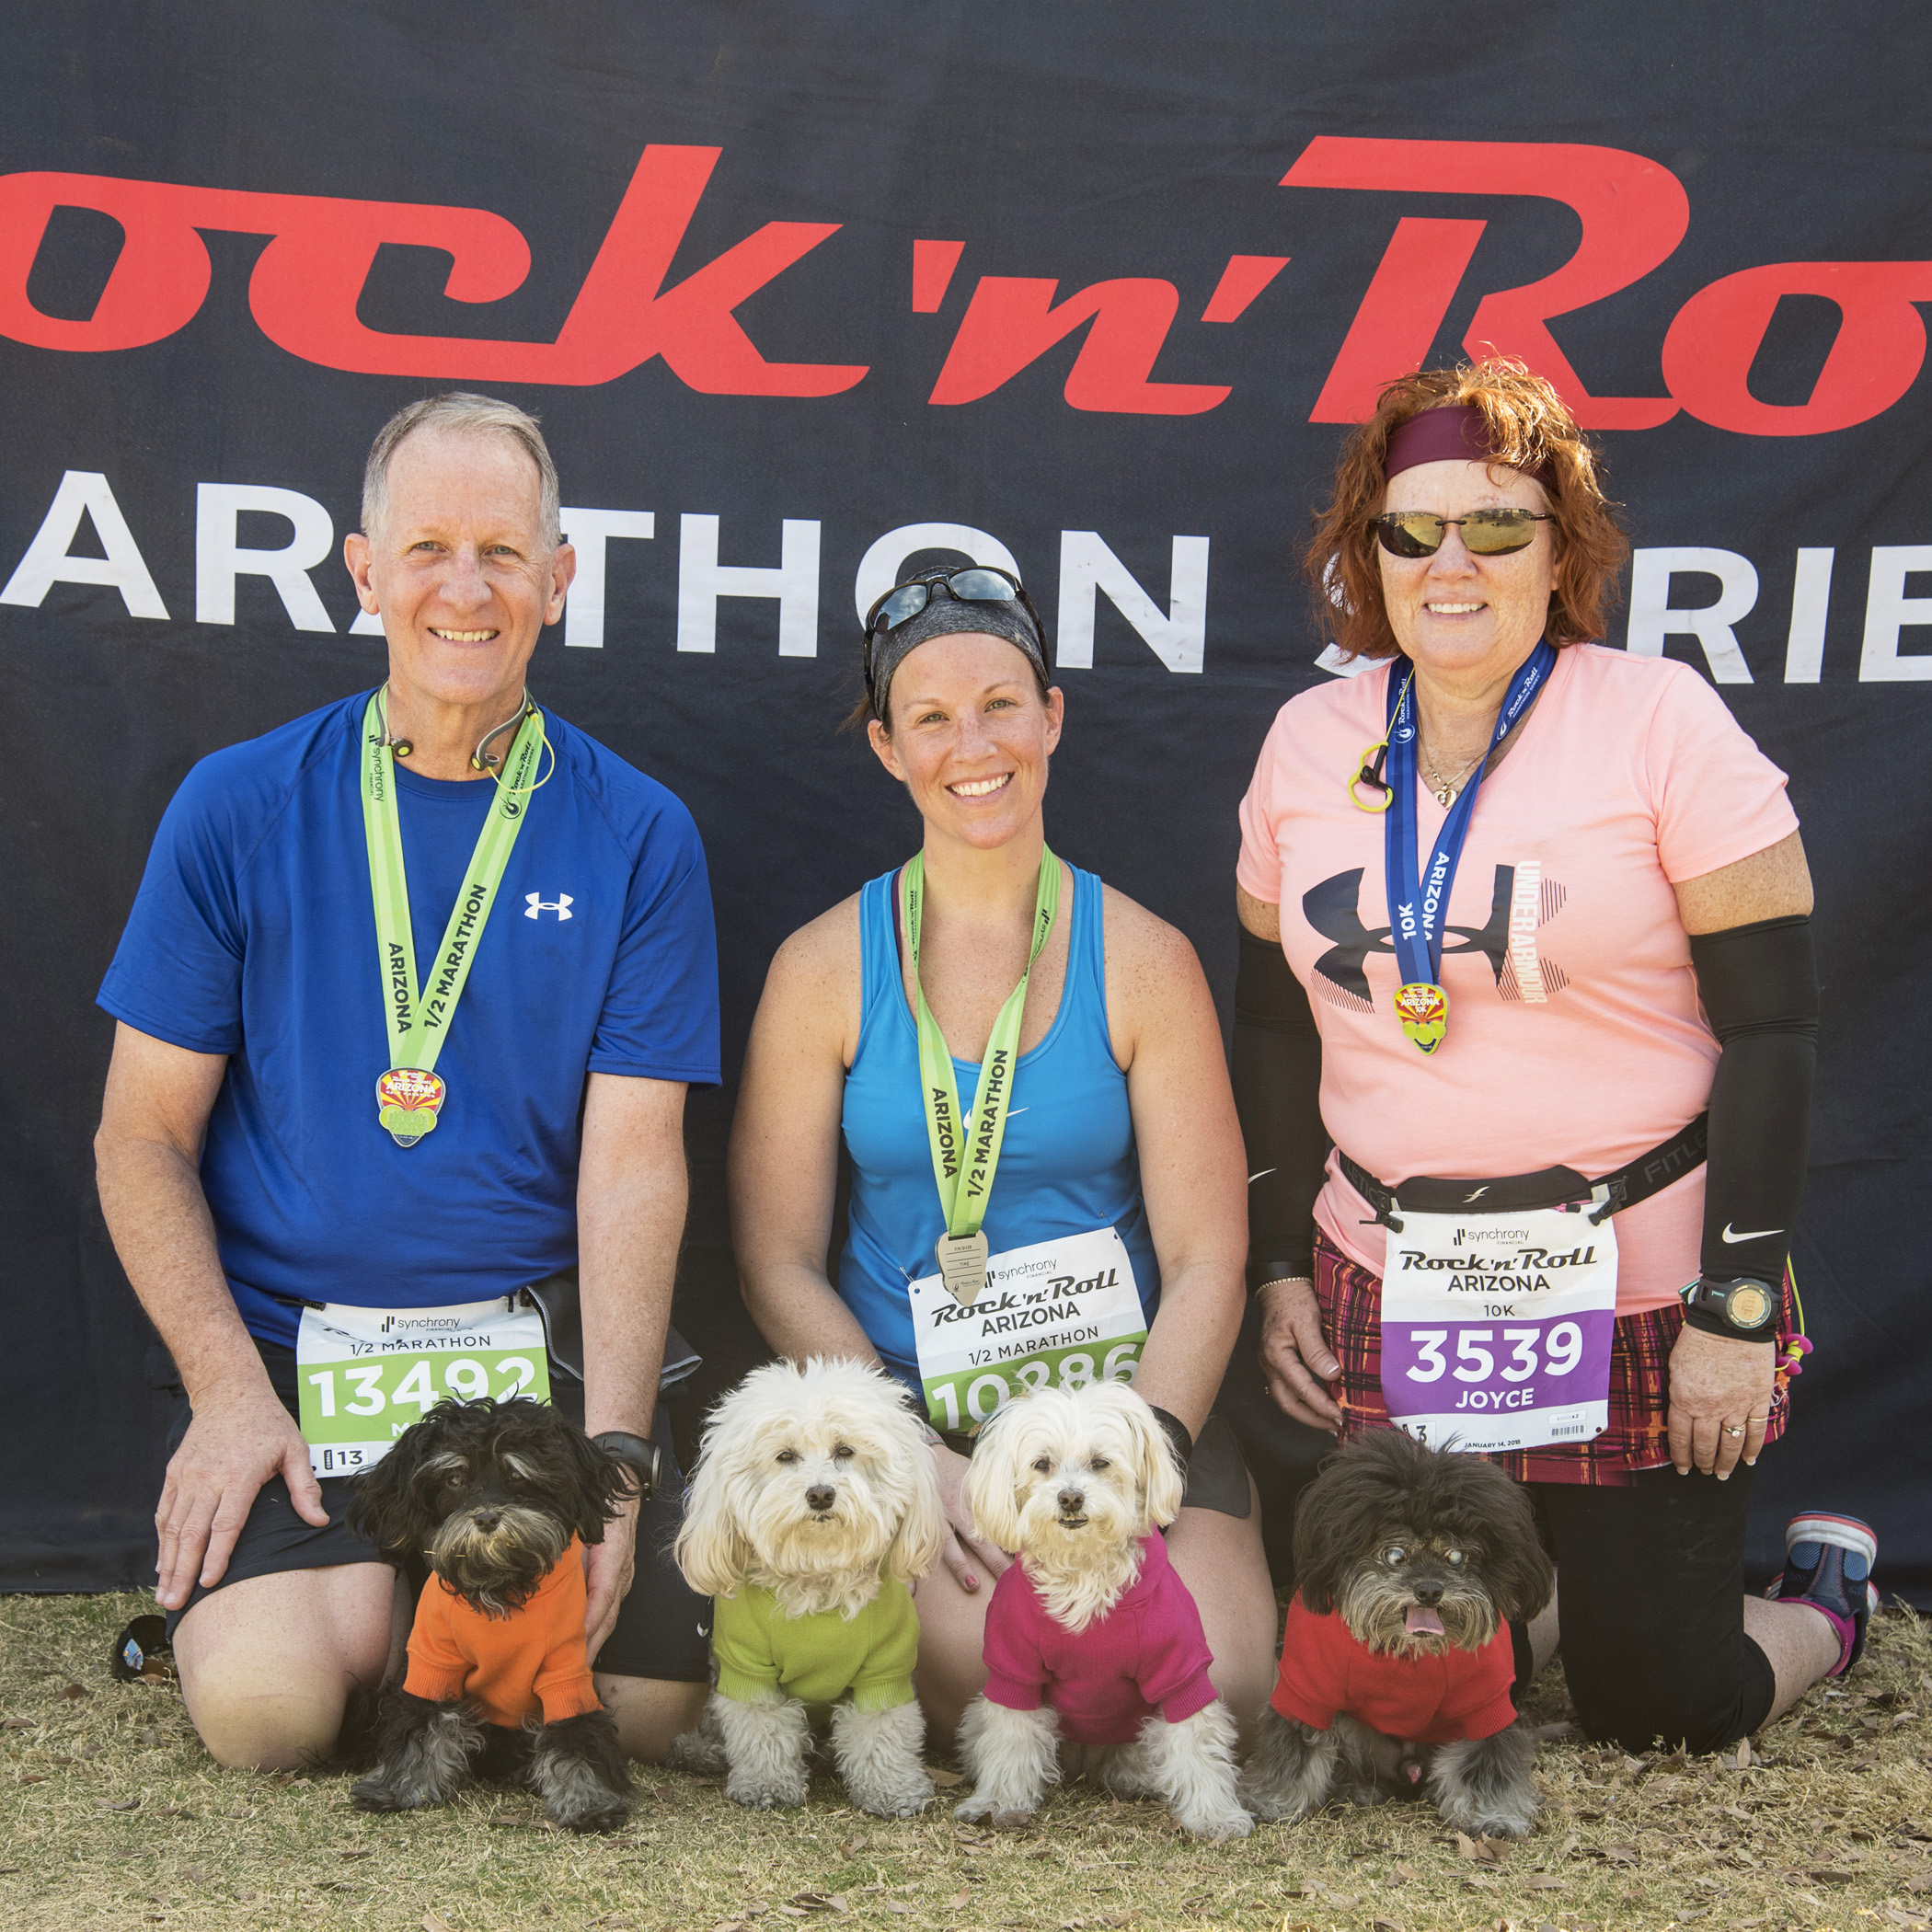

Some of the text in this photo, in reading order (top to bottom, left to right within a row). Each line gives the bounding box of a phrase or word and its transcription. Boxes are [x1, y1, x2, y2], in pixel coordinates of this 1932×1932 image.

[0, 144, 870, 397] ock
[1507, 693, 1524, 718] Rock
[1524, 666, 1539, 687] Roll
[519, 741, 532, 763] Roll
[372, 747, 385, 802] synchrony
[1398, 902, 1417, 940] 10K
[1511, 860, 1548, 1004] UNDER ARMOUR
[423, 883, 487, 1029] 1/2 MARATHON
[388, 942, 412, 1034] ARIZONA
[1400, 997, 1440, 1007] ARIZONA
[385, 1081, 436, 1095] ARIZONA
[932, 1087, 958, 1179] ARIZONA
[967, 1050, 1008, 1197] 1/2 MARATHON
[1643, 1128, 1708, 1183] FITLE
[1468, 1228, 1529, 1242] synchrony
[998, 1259, 1057, 1280] synchrony
[1026, 1270, 1052, 1279] FINANCIAL
[1399, 1249, 1489, 1271] Rock
[1517, 1246, 1598, 1270] Roll
[931, 1292, 1021, 1328] Rock
[1046, 1268, 1120, 1300] Roll
[1447, 1274, 1550, 1292] ARIZONA
[397, 1317, 460, 1331] synchrony
[981, 1301, 1081, 1337] ARIZONA
[1483, 1305, 1515, 1317] 10K
[350, 1336, 491, 1356] 1/2 MARATHON
[968, 1326, 1099, 1366] 1/2 MARATHON
[1406, 1321, 1583, 1383] 3539
[307, 1356, 538, 1417] 13492
[931, 1343, 1139, 1430] 10286
[1455, 1387, 1534, 1409] JOYCE
[1416, 1425, 1427, 1443] 3
[337, 1450, 362, 1465] 13
